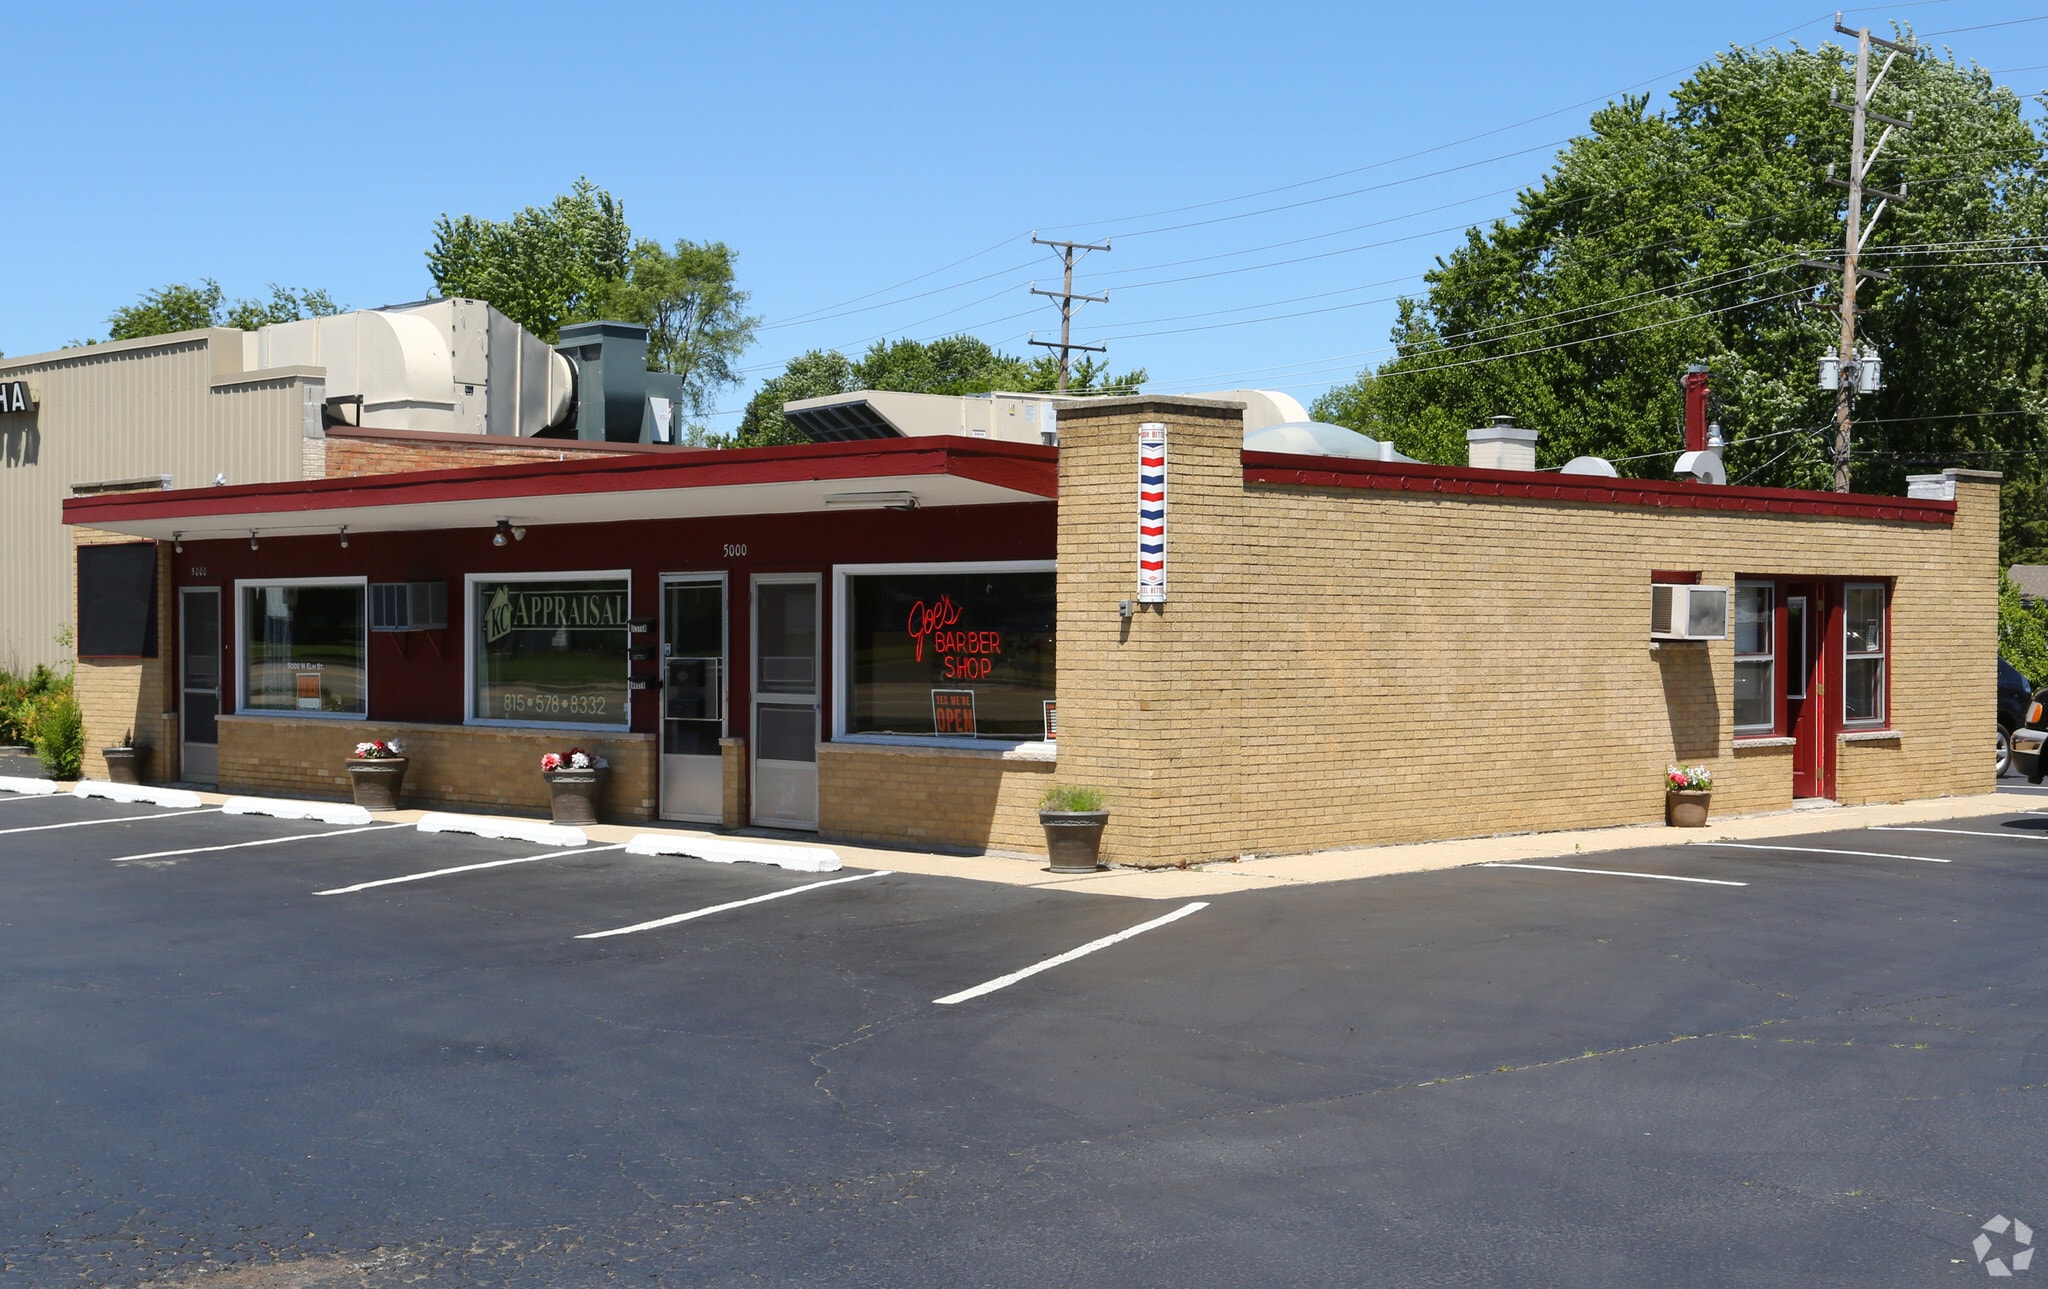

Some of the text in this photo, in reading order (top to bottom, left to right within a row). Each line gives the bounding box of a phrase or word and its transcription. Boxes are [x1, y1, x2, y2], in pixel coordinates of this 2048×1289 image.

[723, 543, 748, 558] 5000
[491, 592, 627, 637] KC APPRAISAL
[907, 593, 963, 663] Joe's
[935, 631, 1002, 654] BARBER
[287, 662, 300, 670] 5000
[301, 662, 306, 670] W
[944, 655, 992, 679] SHOP
[935, 695, 971, 706] YES WE'RE
[937, 707, 974, 733] OPEN
